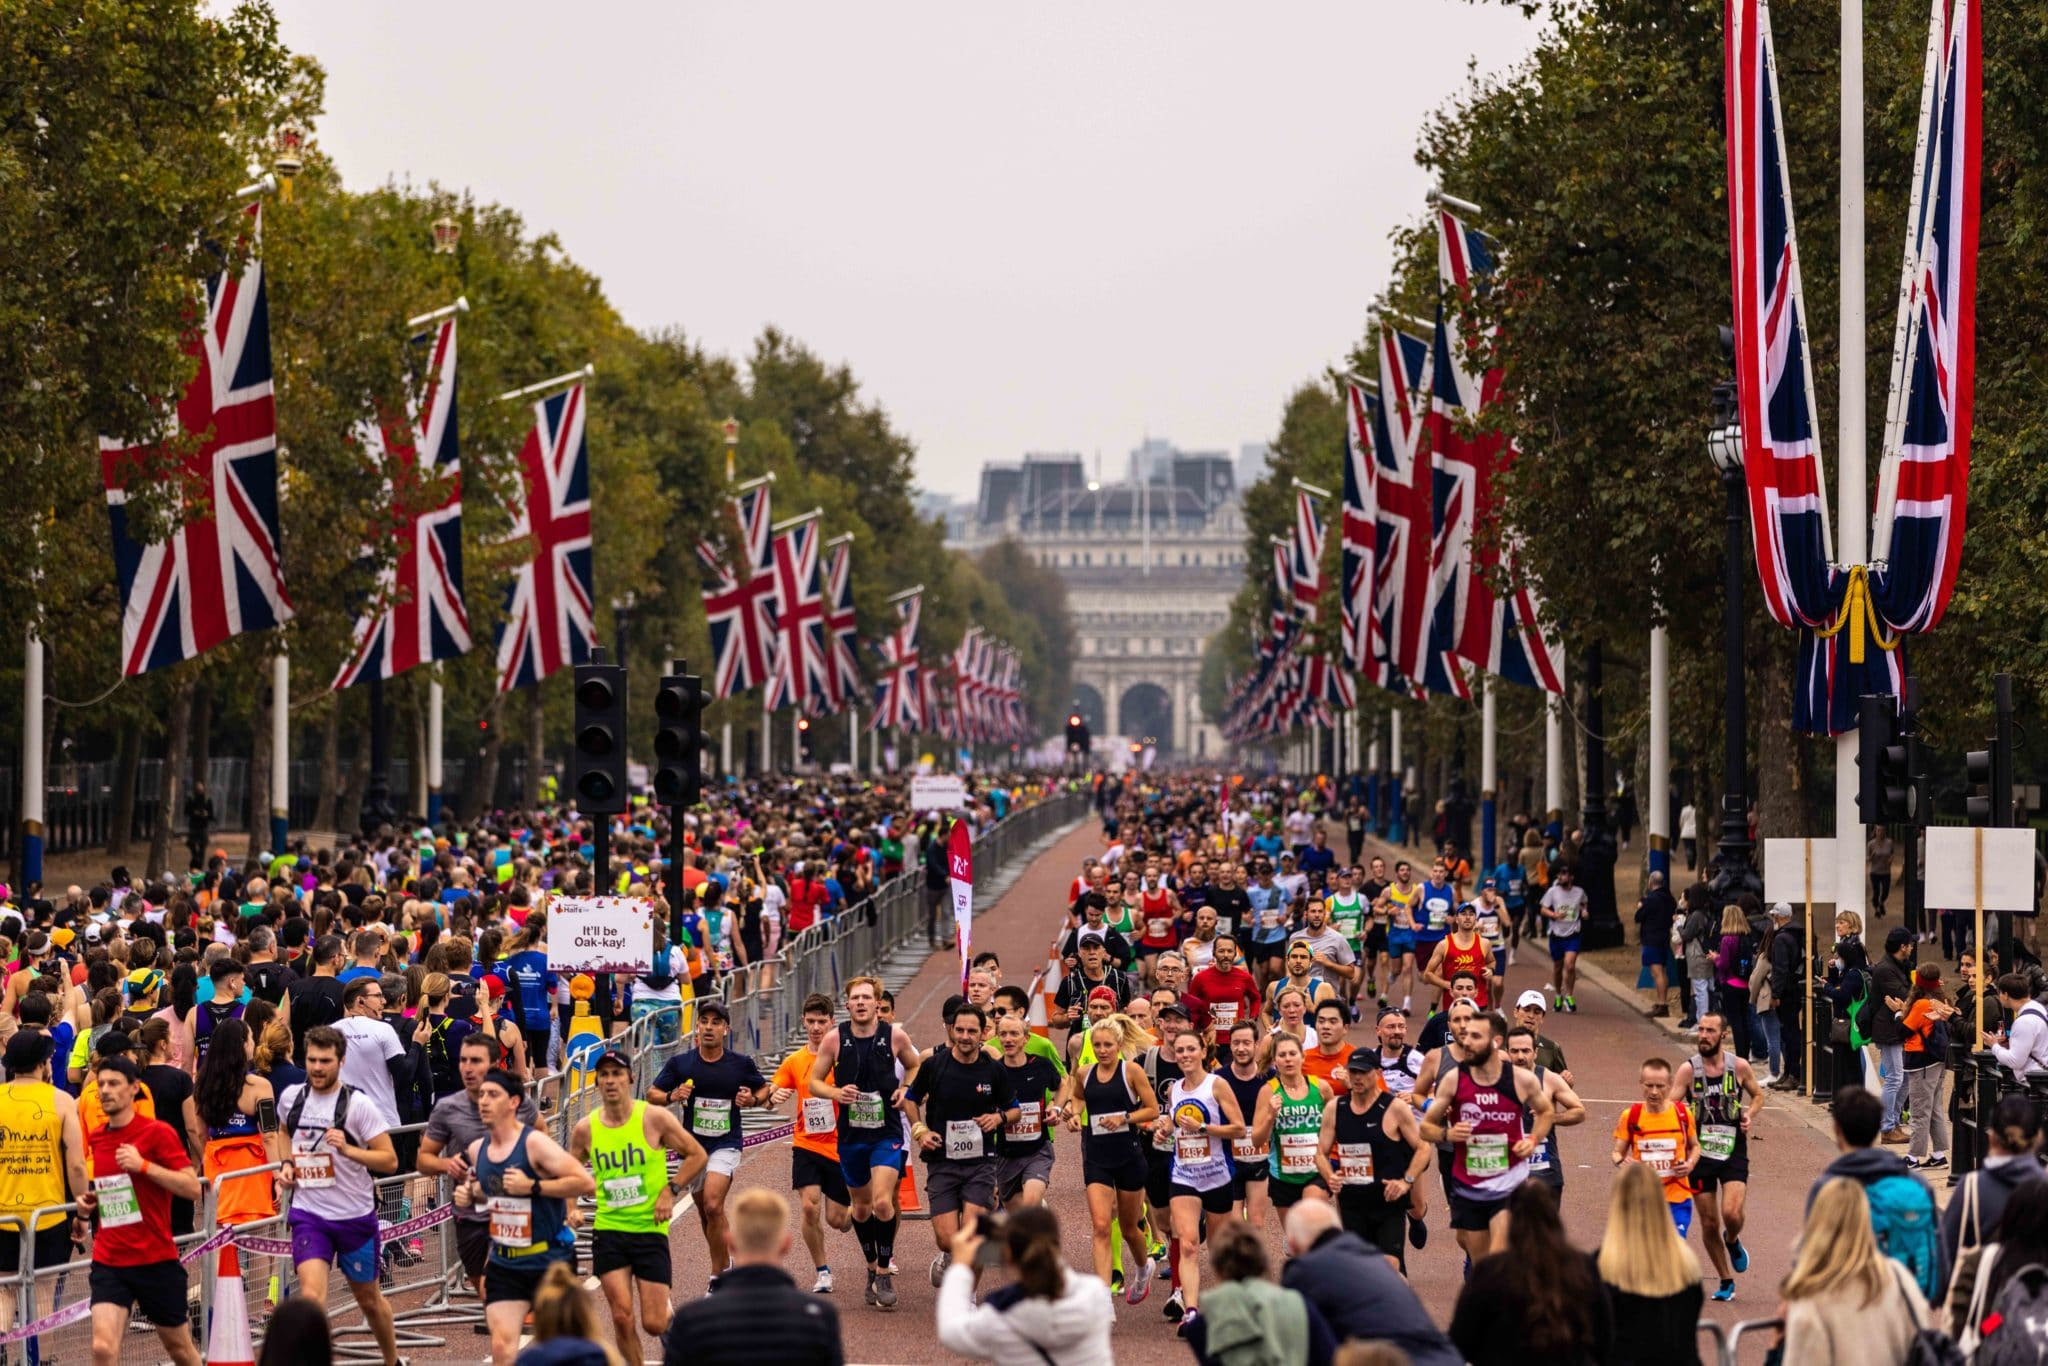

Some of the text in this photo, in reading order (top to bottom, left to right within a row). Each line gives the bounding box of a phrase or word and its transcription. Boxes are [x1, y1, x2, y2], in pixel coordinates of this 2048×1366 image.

[604, 926, 618, 936] be
[574, 937, 626, 949] Oak-kay!
[1474, 1093, 1498, 1105] TOM
[1277, 1104, 1320, 1117] KENDAL
[809, 1116, 826, 1126] 831
[1012, 1124, 1034, 1133] 1271
[954, 1142, 972, 1151] 200
[594, 1142, 645, 1173] hyh
[1182, 1148, 1204, 1158] 1482
[300, 1168, 326, 1177] 1013
